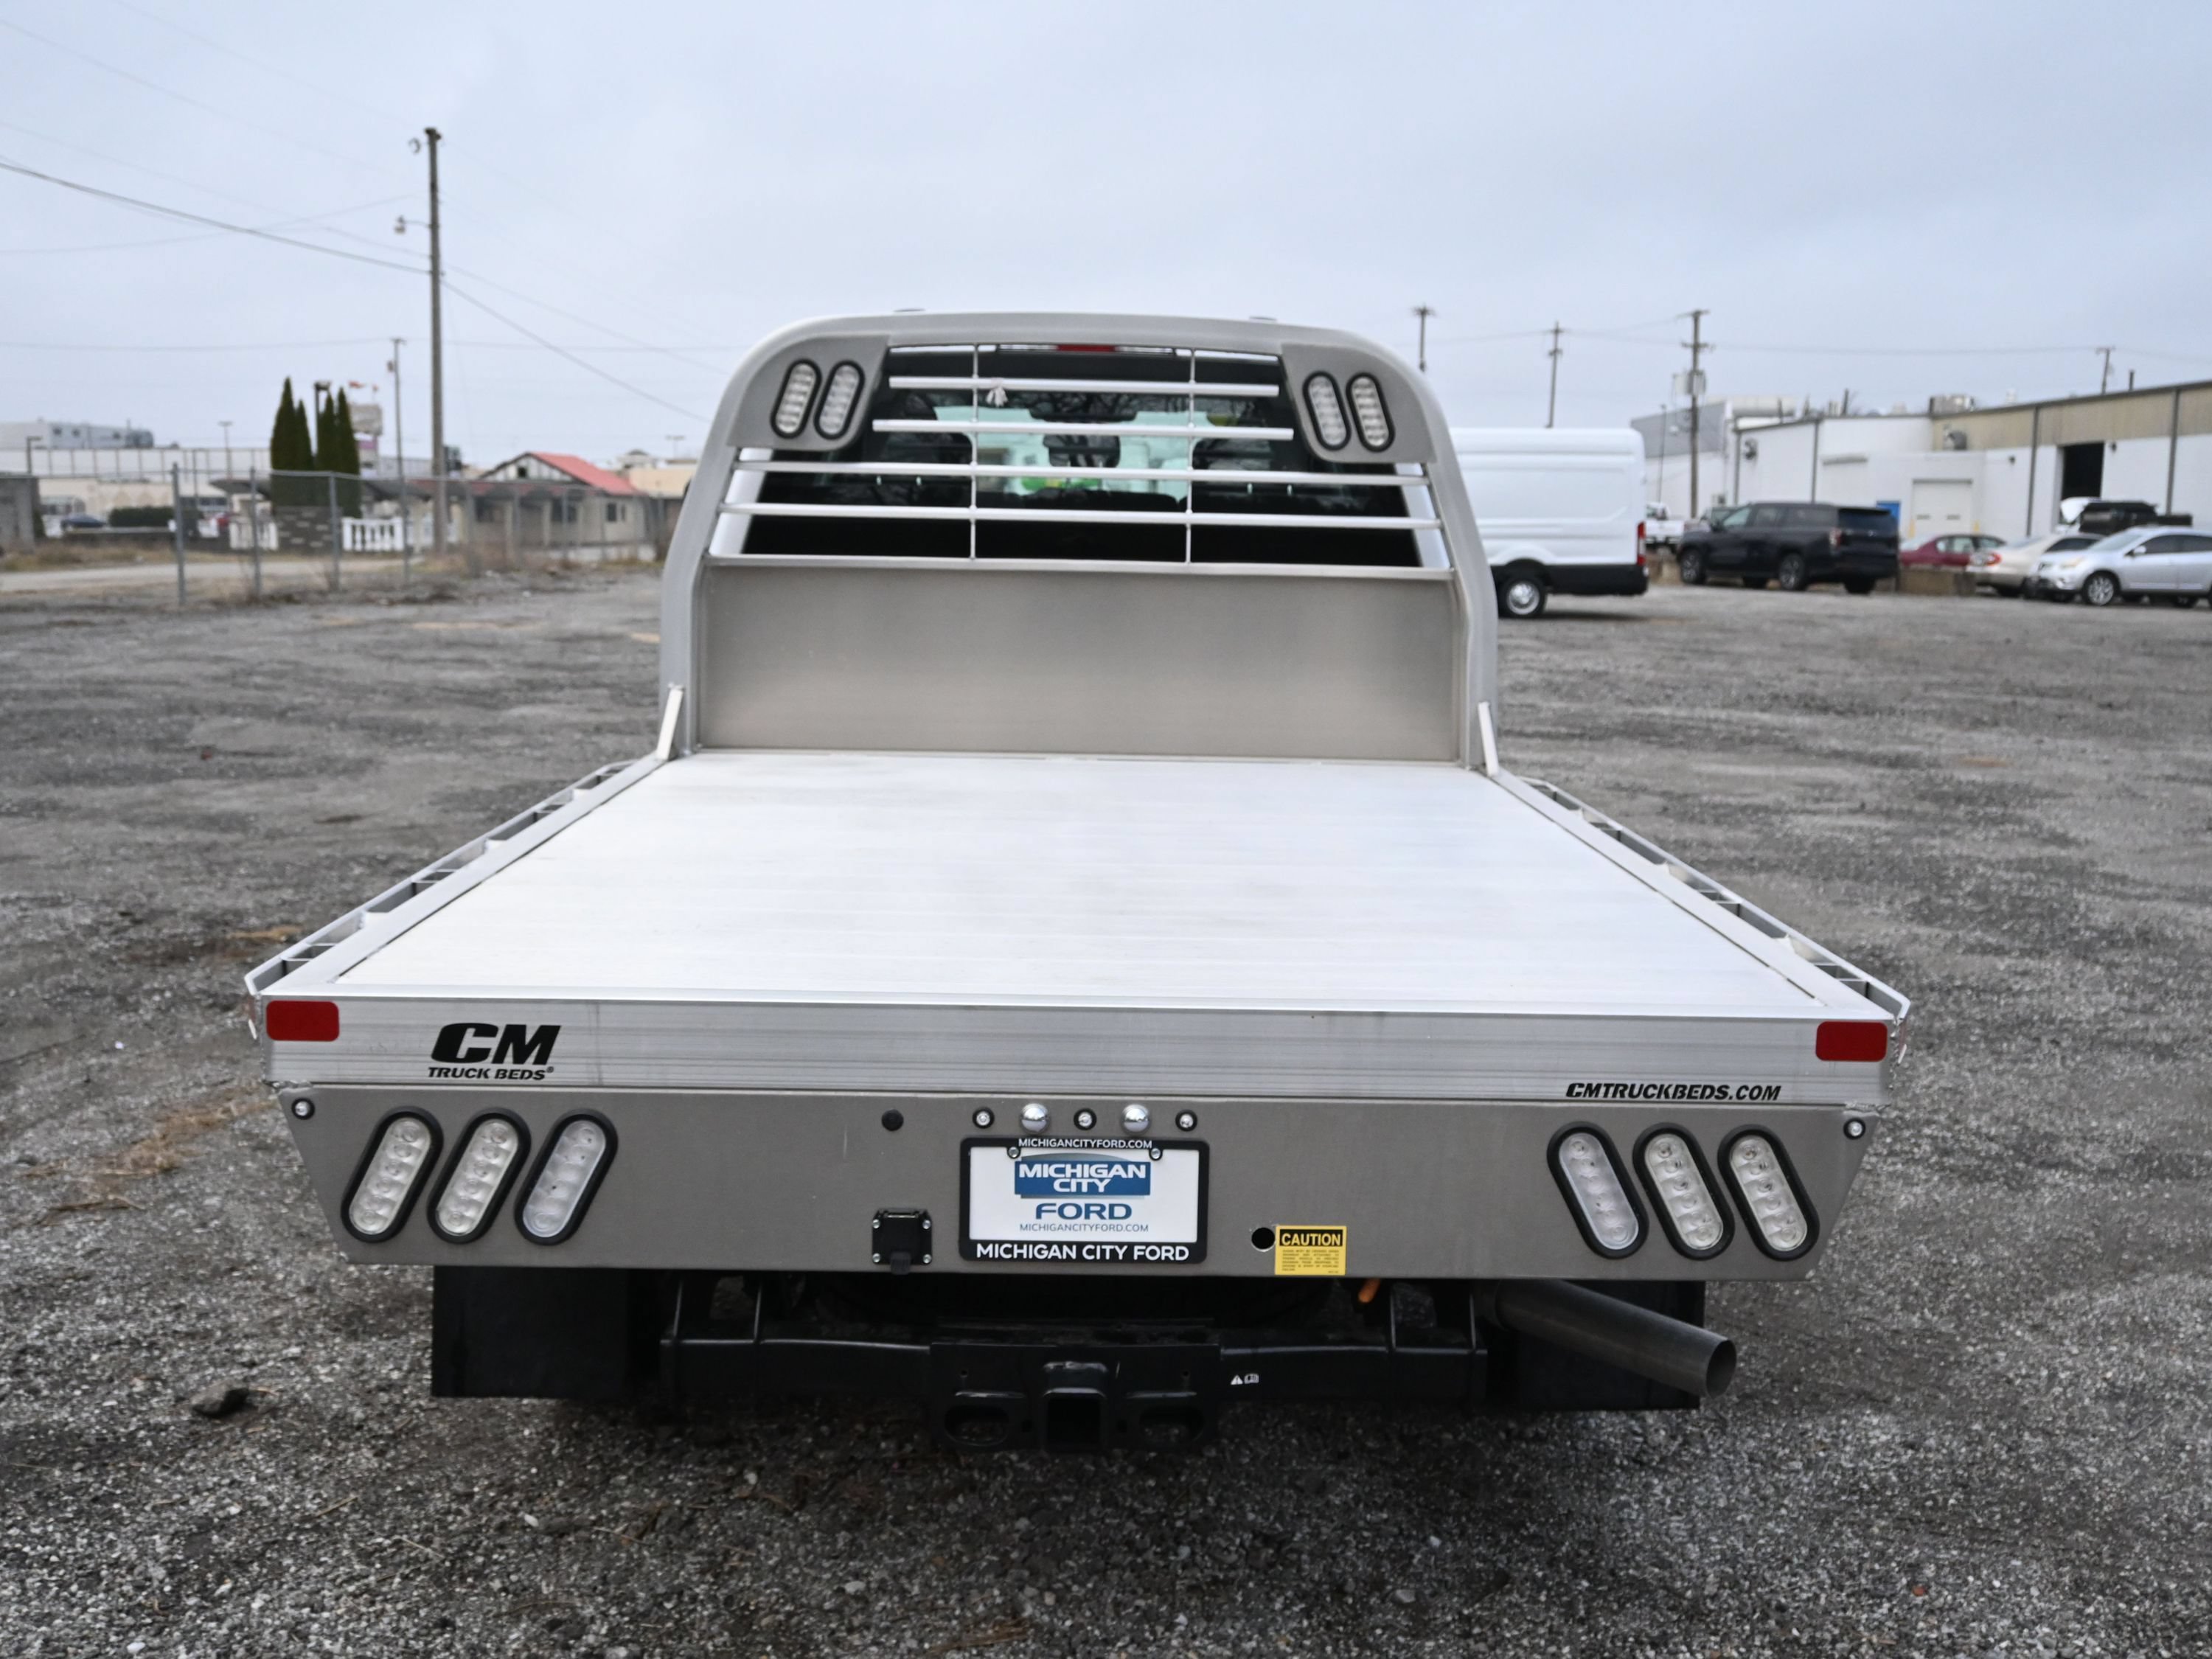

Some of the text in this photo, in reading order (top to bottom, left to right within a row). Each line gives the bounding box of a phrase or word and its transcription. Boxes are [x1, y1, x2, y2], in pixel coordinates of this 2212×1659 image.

[431, 1023, 561, 1065] CM
[428, 1067, 490, 1079] TRUCK
[1565, 1082, 1781, 1101] CMTRUCKBEDS.COM
[1018, 1138, 1152, 1149] MICHIGANCITYFORD.COM
[1018, 1164, 1146, 1179] MICHIGAN
[1053, 1178, 1111, 1193] CITY
[1035, 1203, 1133, 1220] FORD
[1020, 1223, 1149, 1233] MICHIGANCITYFORD.COM
[1281, 1233, 1341, 1246] CAUTION
[976, 1243, 1189, 1262] MICHIGAN CITY FORD
